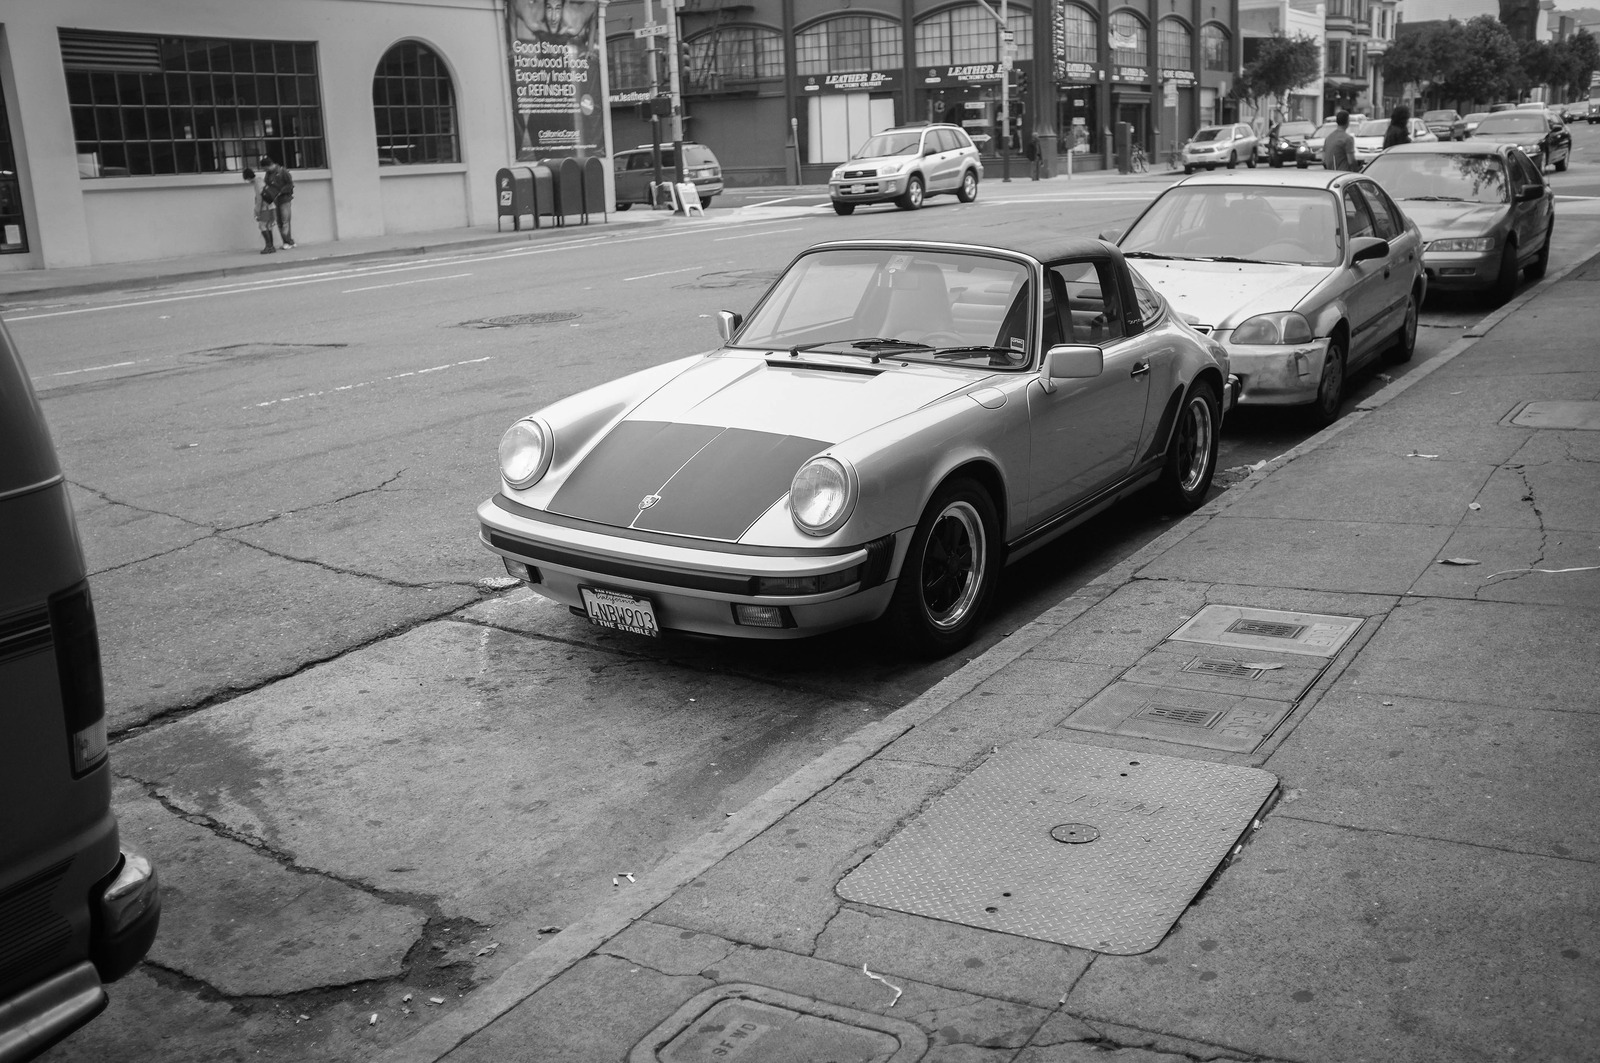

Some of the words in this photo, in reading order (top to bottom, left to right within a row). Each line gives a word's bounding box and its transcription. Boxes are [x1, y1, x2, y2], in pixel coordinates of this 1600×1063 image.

[513, 40, 541, 53] Good
[541, 41, 570, 57] Strong
[514, 55, 562, 68] Hardwood
[515, 69, 551, 84] Expertly
[552, 69, 588, 82] Installed
[947, 64, 994, 76] LEATHER
[825, 73, 868, 84] LEATHER
[517, 86, 527, 96] or
[528, 84, 576, 96] REFINISHED
[596, 593, 639, 605] California
[590, 601, 654, 630] 4NBW903
[598, 620, 616, 629] THE
[617, 624, 651, 636] STABLE
